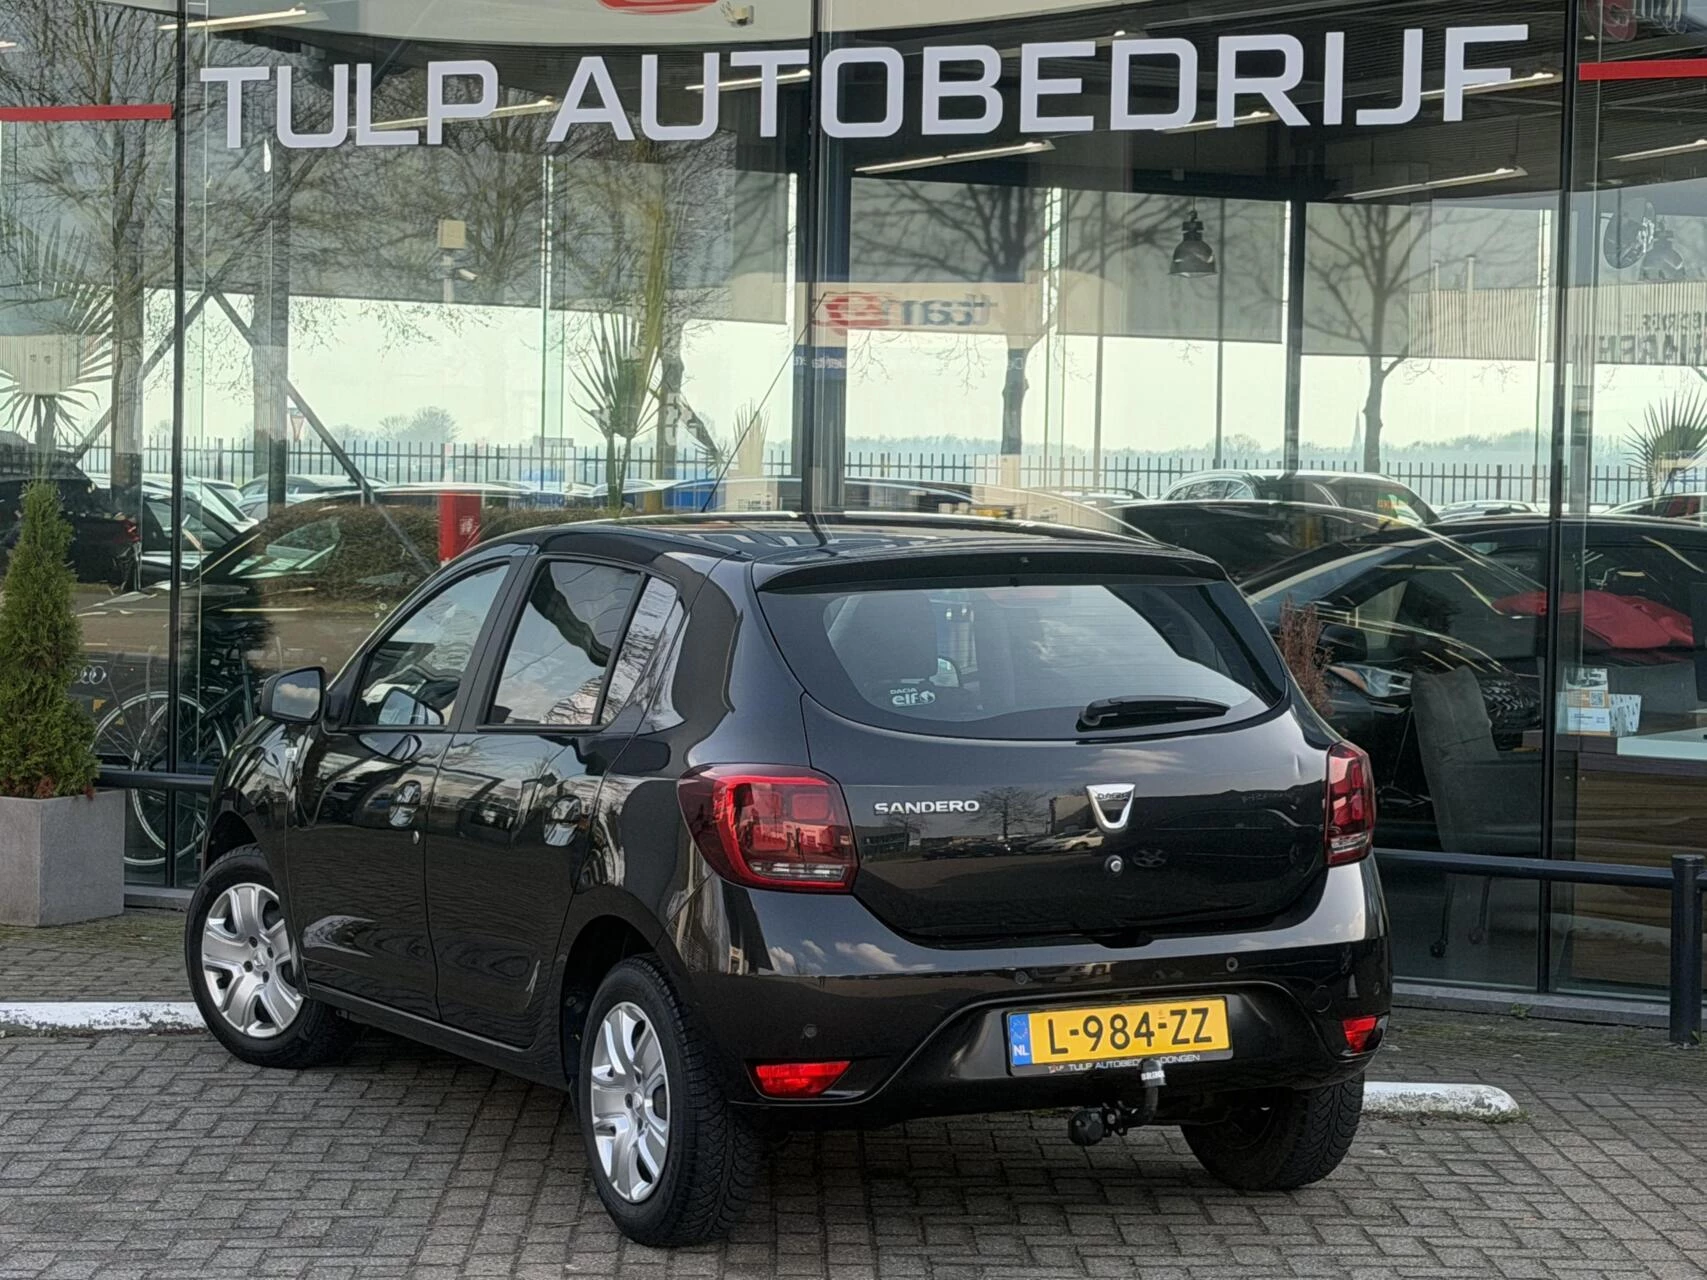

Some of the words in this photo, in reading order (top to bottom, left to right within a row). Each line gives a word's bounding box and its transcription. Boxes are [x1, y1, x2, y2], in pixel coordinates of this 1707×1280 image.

[200, 59, 499, 151] TULP
[546, 24, 1530, 144] AUTOBEDRIJF
[892, 693, 918, 705] elf
[874, 799, 980, 816] SANDERO
[1047, 1007, 1212, 1055] L-984-ZZ
[1013, 1045, 1029, 1057] NL
[1068, 1063, 1093, 1072] TULP
